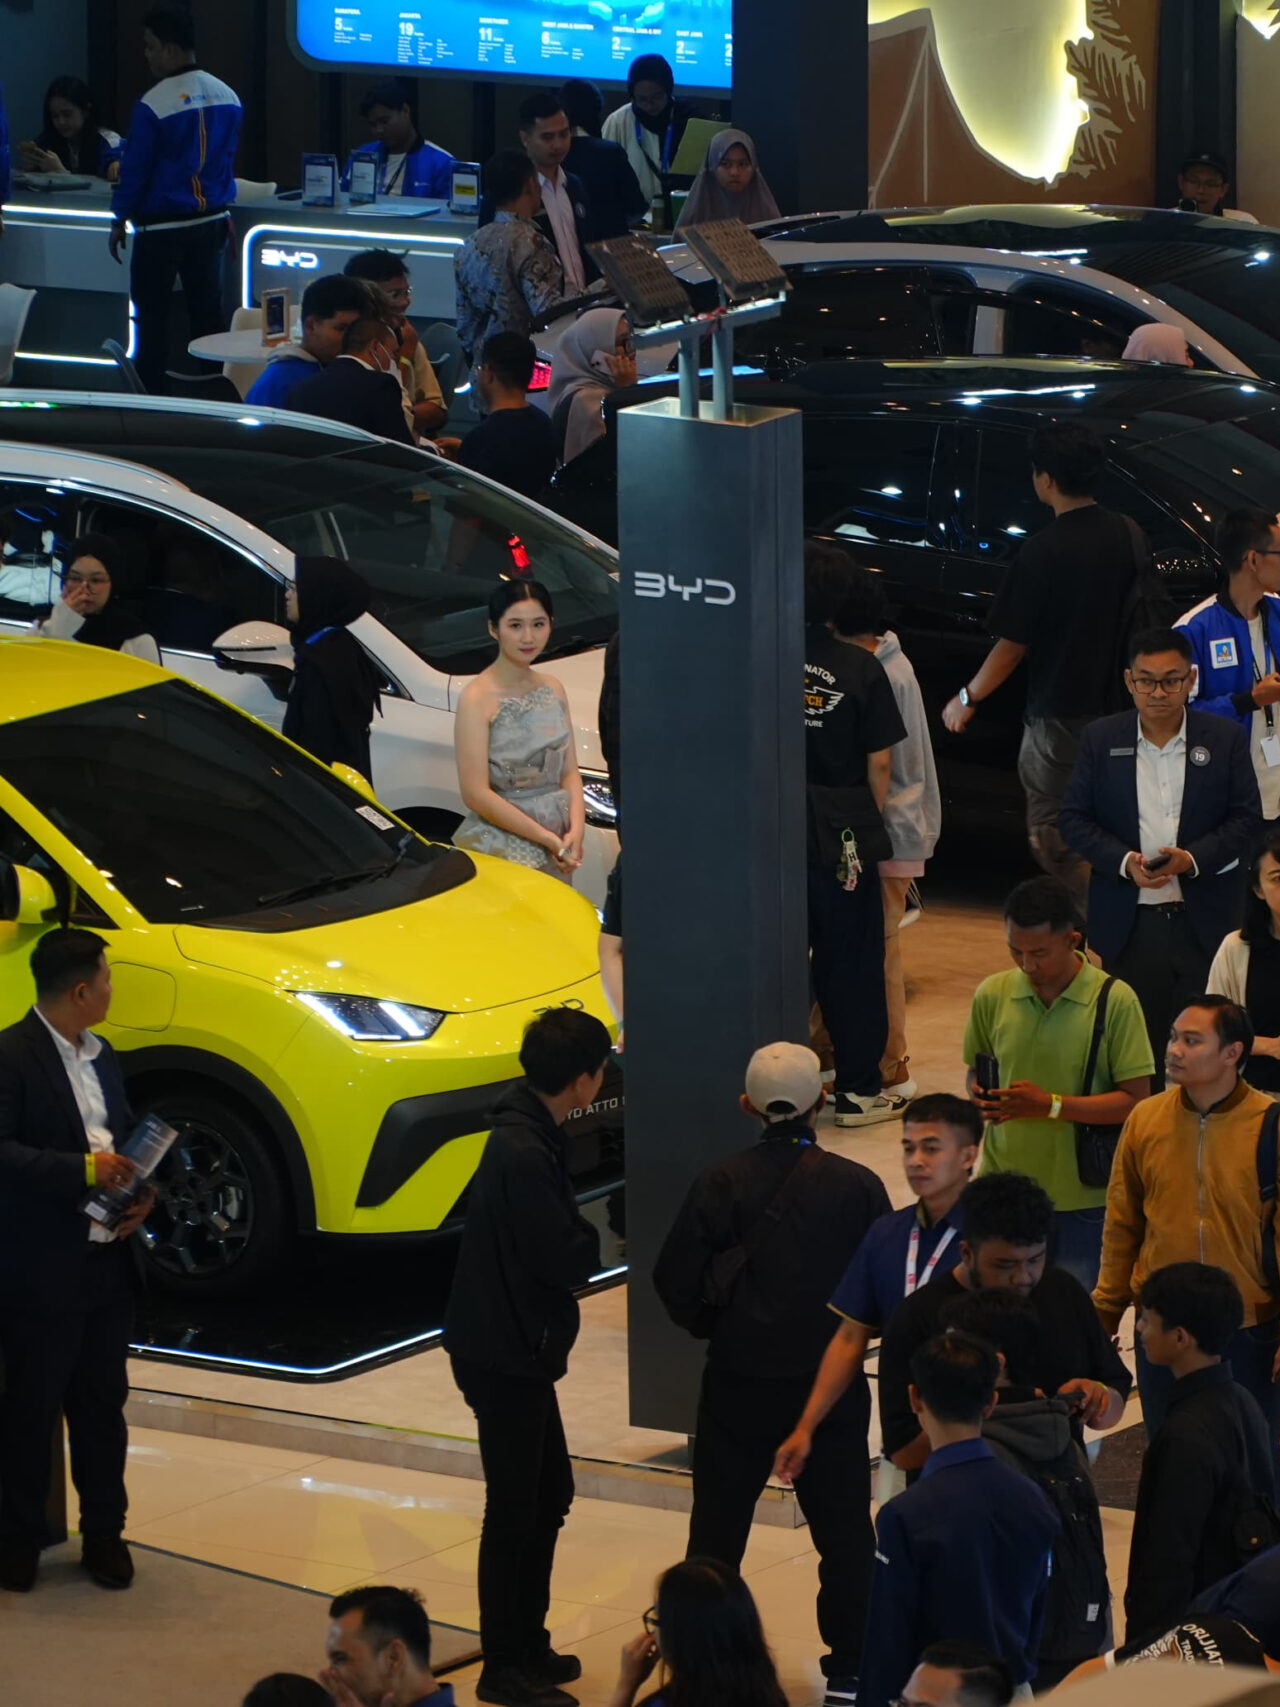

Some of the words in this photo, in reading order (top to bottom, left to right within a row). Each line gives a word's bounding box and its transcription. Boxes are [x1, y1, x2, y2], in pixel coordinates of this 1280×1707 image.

[334, 17, 343, 31] 5
[398, 22, 414, 36] 19
[478, 27, 492, 41] 11
[541, 31, 550, 45] 6
[612, 36, 621, 50] 2
[676, 40, 685, 54] 2
[261, 249, 319, 269] BYD
[634, 571, 736, 606] BYD
[804, 664, 836, 685] NATOR
[804, 719, 823, 728] TURE
[1194, 752, 1205, 762] 19
[567, 1107, 583, 1120] YD
[586, 1098, 618, 1115] ATTO
